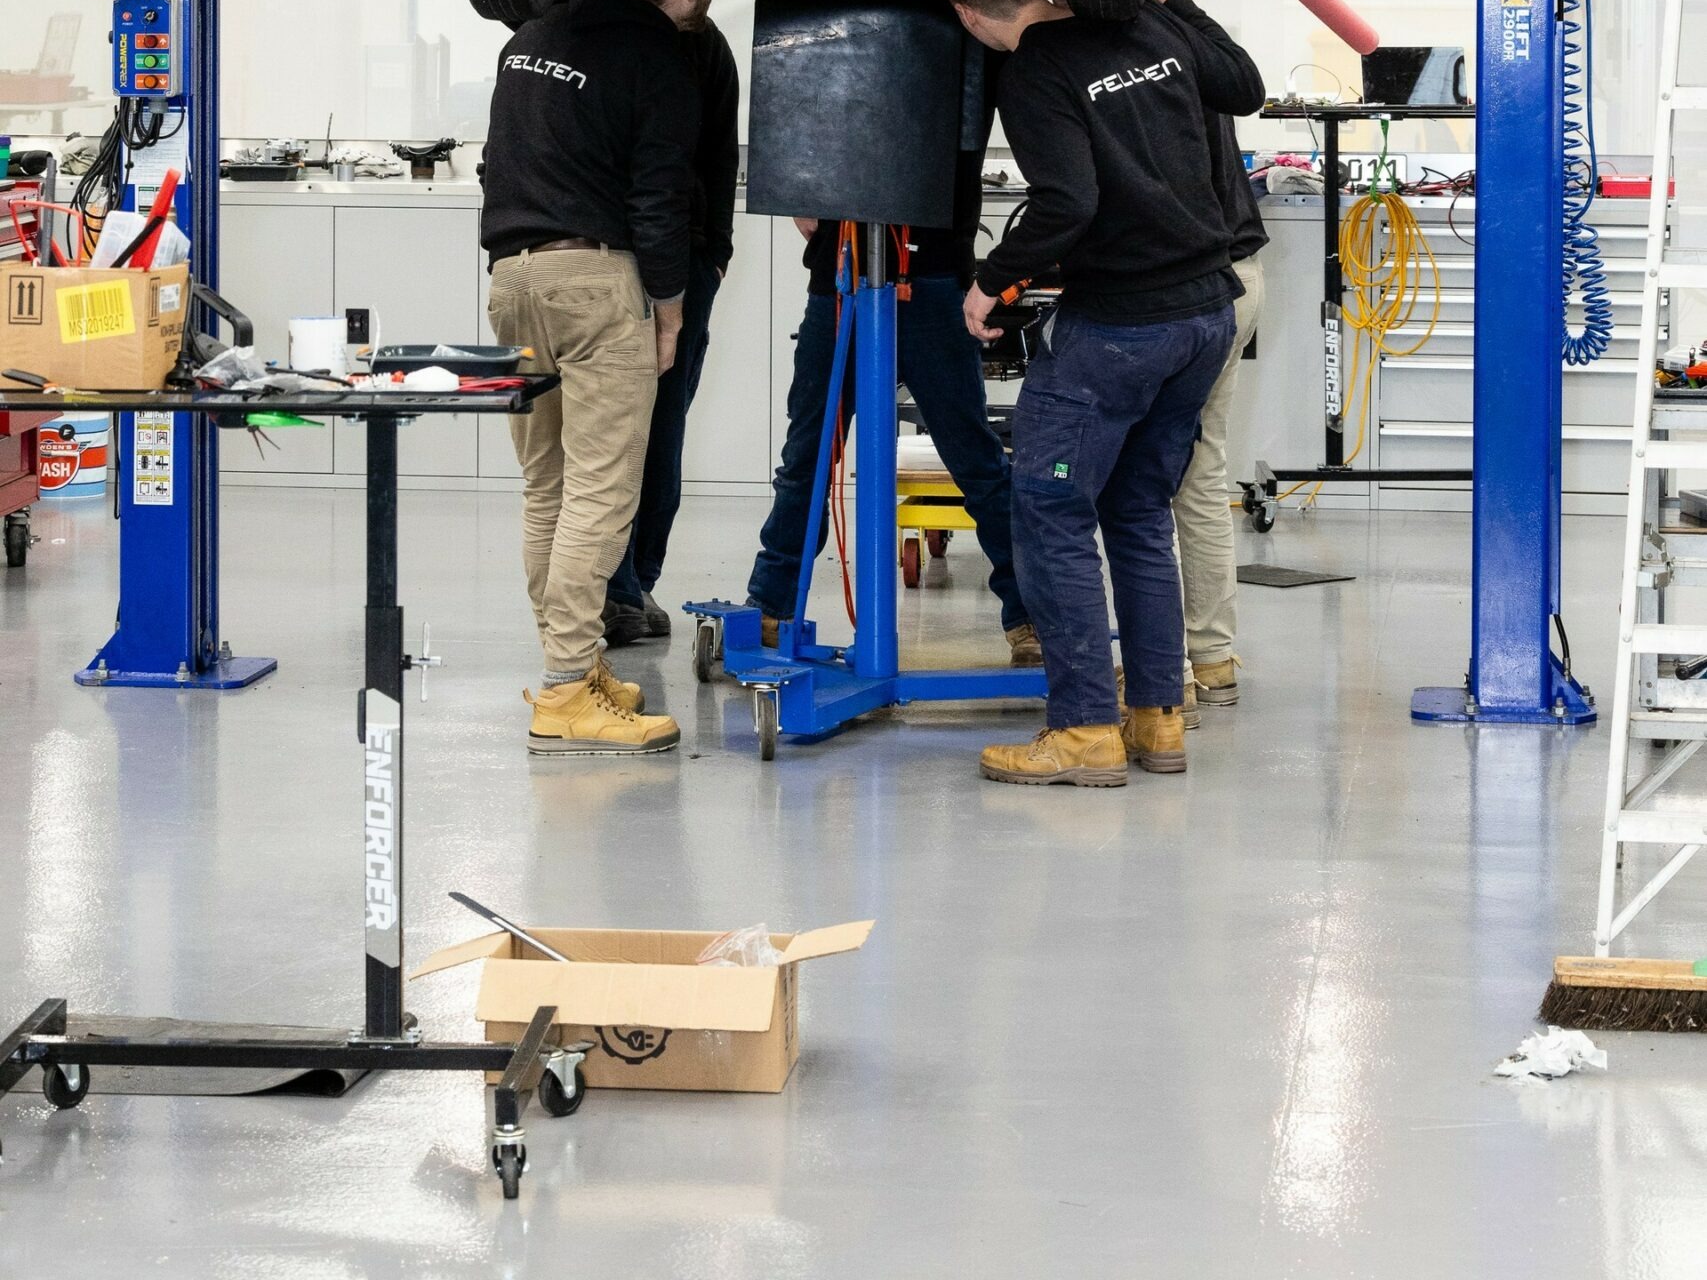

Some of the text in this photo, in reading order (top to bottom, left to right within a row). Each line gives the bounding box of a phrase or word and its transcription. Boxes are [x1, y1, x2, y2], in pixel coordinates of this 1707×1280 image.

[119, 33, 128, 88] POWERREX
[1516, 9, 1530, 61] LIFT
[502, 54, 588, 90] FELLTEN
[1325, 318, 1341, 416] ENFORCER
[40, 461, 71, 477] ASH
[365, 726, 397, 931] ENFORCER
